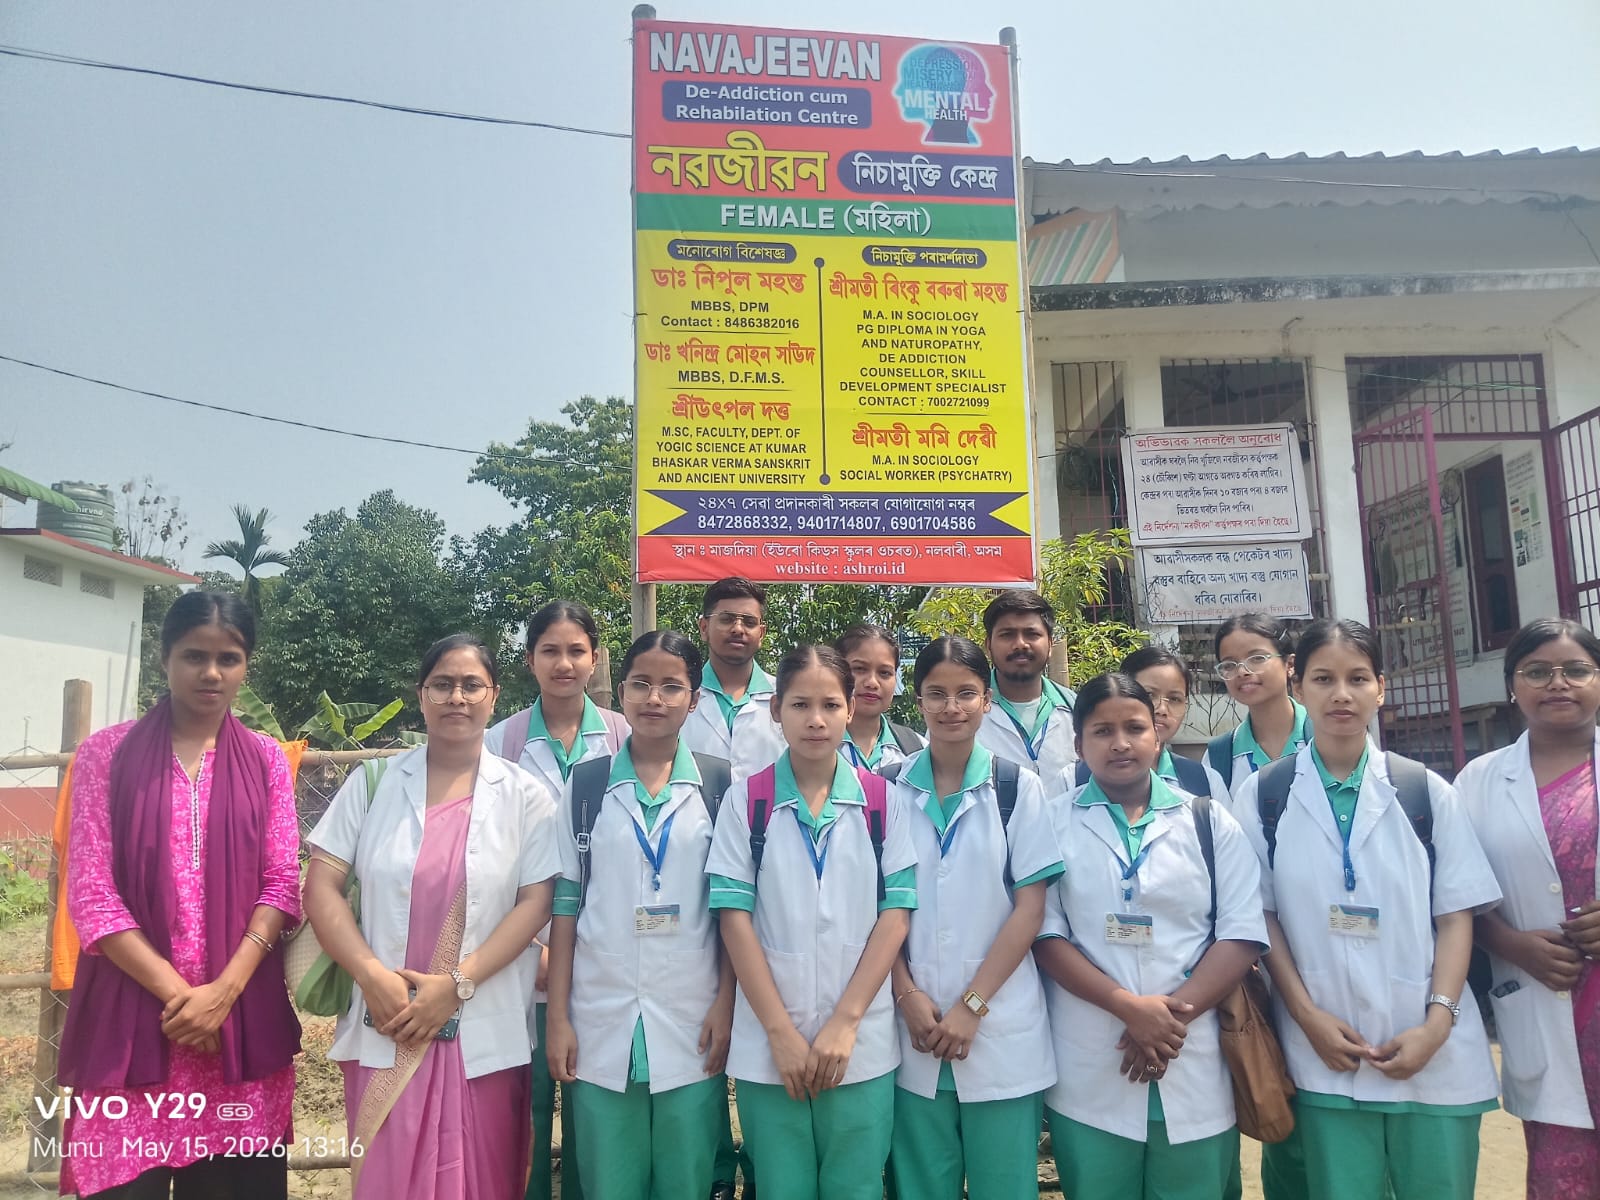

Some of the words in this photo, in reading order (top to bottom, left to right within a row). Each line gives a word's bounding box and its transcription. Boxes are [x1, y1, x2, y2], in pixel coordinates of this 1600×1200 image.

[650, 32, 882, 80] NAVAJEEVAN
[903, 67, 953, 82] MISERY
[685, 84, 804, 103] De-Addiction
[809, 91, 848, 105] cum
[904, 89, 986, 112] MENTAL
[676, 104, 792, 123] Rehabilation
[798, 107, 858, 125] Centre
[924, 107, 968, 121] HEALTH
[648, 130, 829, 192] নৱজীৱন
[720, 203, 835, 229] FEMALE
[843, 201, 931, 236] (মহিলা)
[692, 262, 751, 296] নিপুল
[757, 271, 807, 295] মহন্ত
[971, 282, 1009, 303] মহন্ত
[691, 300, 735, 313] MBBS,
[739, 302, 769, 313] DPM
[661, 316, 713, 328] Contact
[724, 317, 800, 329] 8486382016
[863, 310, 888, 320] M.A.
[891, 310, 903, 320] IN
[906, 311, 979, 322] SOCIOLOGY
[857, 324, 874, 334] PG
[877, 324, 933, 335] DIPLOMA
[936, 325, 948, 335] IN
[951, 325, 986, 336] YOGA
[861, 339, 887, 349] AND
[891, 339, 983, 351] NATUROPATHY,
[726, 344, 771, 367] মোহন
[774, 340, 816, 366] সাউদ
[879, 353, 895, 363] DE
[899, 354, 966, 364] ADDICTION
[678, 370, 725, 384] MBBS,
[729, 371, 785, 384] D.F.M.S.
[860, 367, 948, 379] COUNSELLOR,
[951, 368, 986, 379] SKILL
[840, 381, 932, 392] DEVELOPMENT
[936, 382, 1006, 393] SPECIALIST
[859, 396, 917, 407] CONTACT
[927, 397, 990, 408] 7002721099
[760, 401, 791, 421] দত্ত
[662, 426, 692, 438] M.SC,
[695, 427, 748, 439] FACULTY,
[752, 428, 783, 438] DEPT.
[786, 428, 801, 438] OF
[915, 422, 950, 449] মমি
[656, 441, 692, 452] YOGIC
[696, 442, 745, 453] SCIENCE
[748, 443, 762, 453] AT
[766, 443, 807, 454] KUMAR
[652, 457, 708, 468] BHASKAR
[711, 458, 752, 468] VERMA
[754, 458, 811, 469] SANSKRIT
[872, 455, 895, 465] M.A.
[898, 455, 909, 465] IN
[913, 455, 979, 466] SOCIOLOGY
[658, 472, 682, 483] AND
[685, 473, 736, 484] ANCIENT
[739, 473, 806, 484] UNIVERSITY
[840, 470, 882, 481] SOCIAL
[885, 470, 935, 481] WORKER
[938, 470, 1012, 484] (PSYCHATRY)
[838, 498, 879, 511] সকলৰ
[884, 497, 945, 511] যোগাযোগ
[697, 515, 792, 532] 8472868332,
[797, 515, 886, 532] 9401714807,
[890, 516, 976, 530] 6901704586
[974, 545, 1002, 557] অসম
[774, 561, 829, 575] website
[843, 561, 906, 576] ashroi.id
